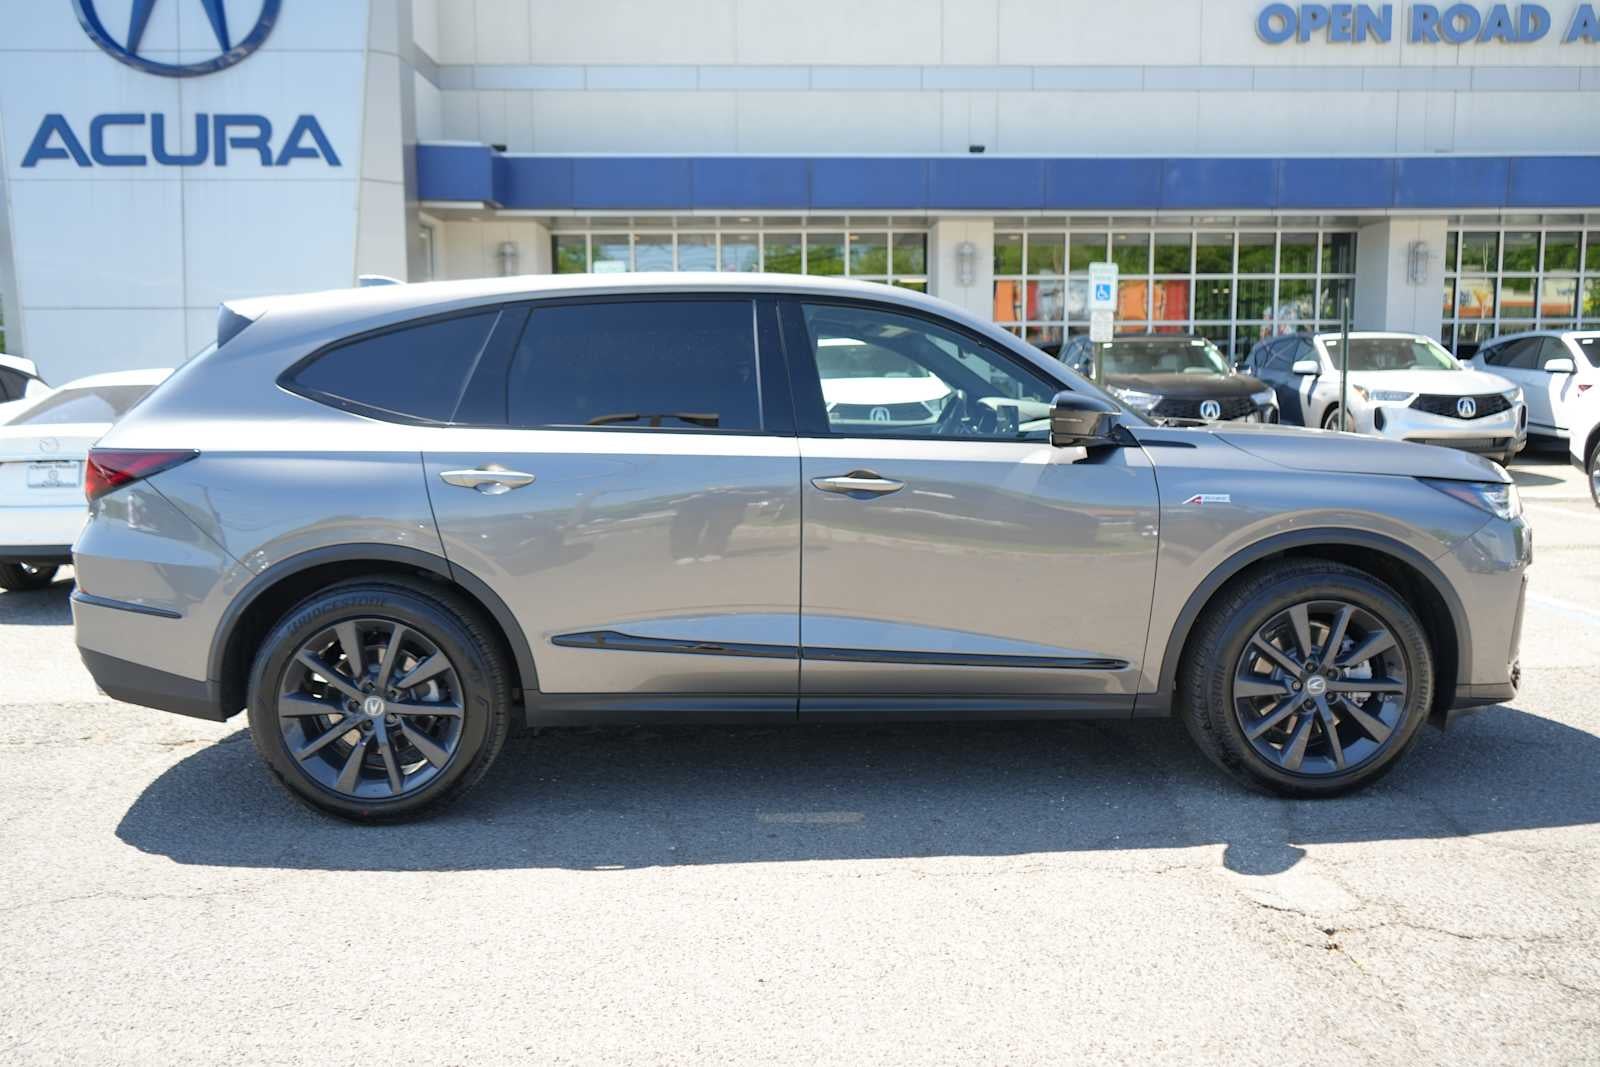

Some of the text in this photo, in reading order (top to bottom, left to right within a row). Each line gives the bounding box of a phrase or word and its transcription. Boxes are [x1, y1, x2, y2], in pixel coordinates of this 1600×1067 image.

[1256, 3, 1393, 44] OPEN
[1408, 3, 1551, 44] ROAD
[21, 113, 342, 168] ACURA
